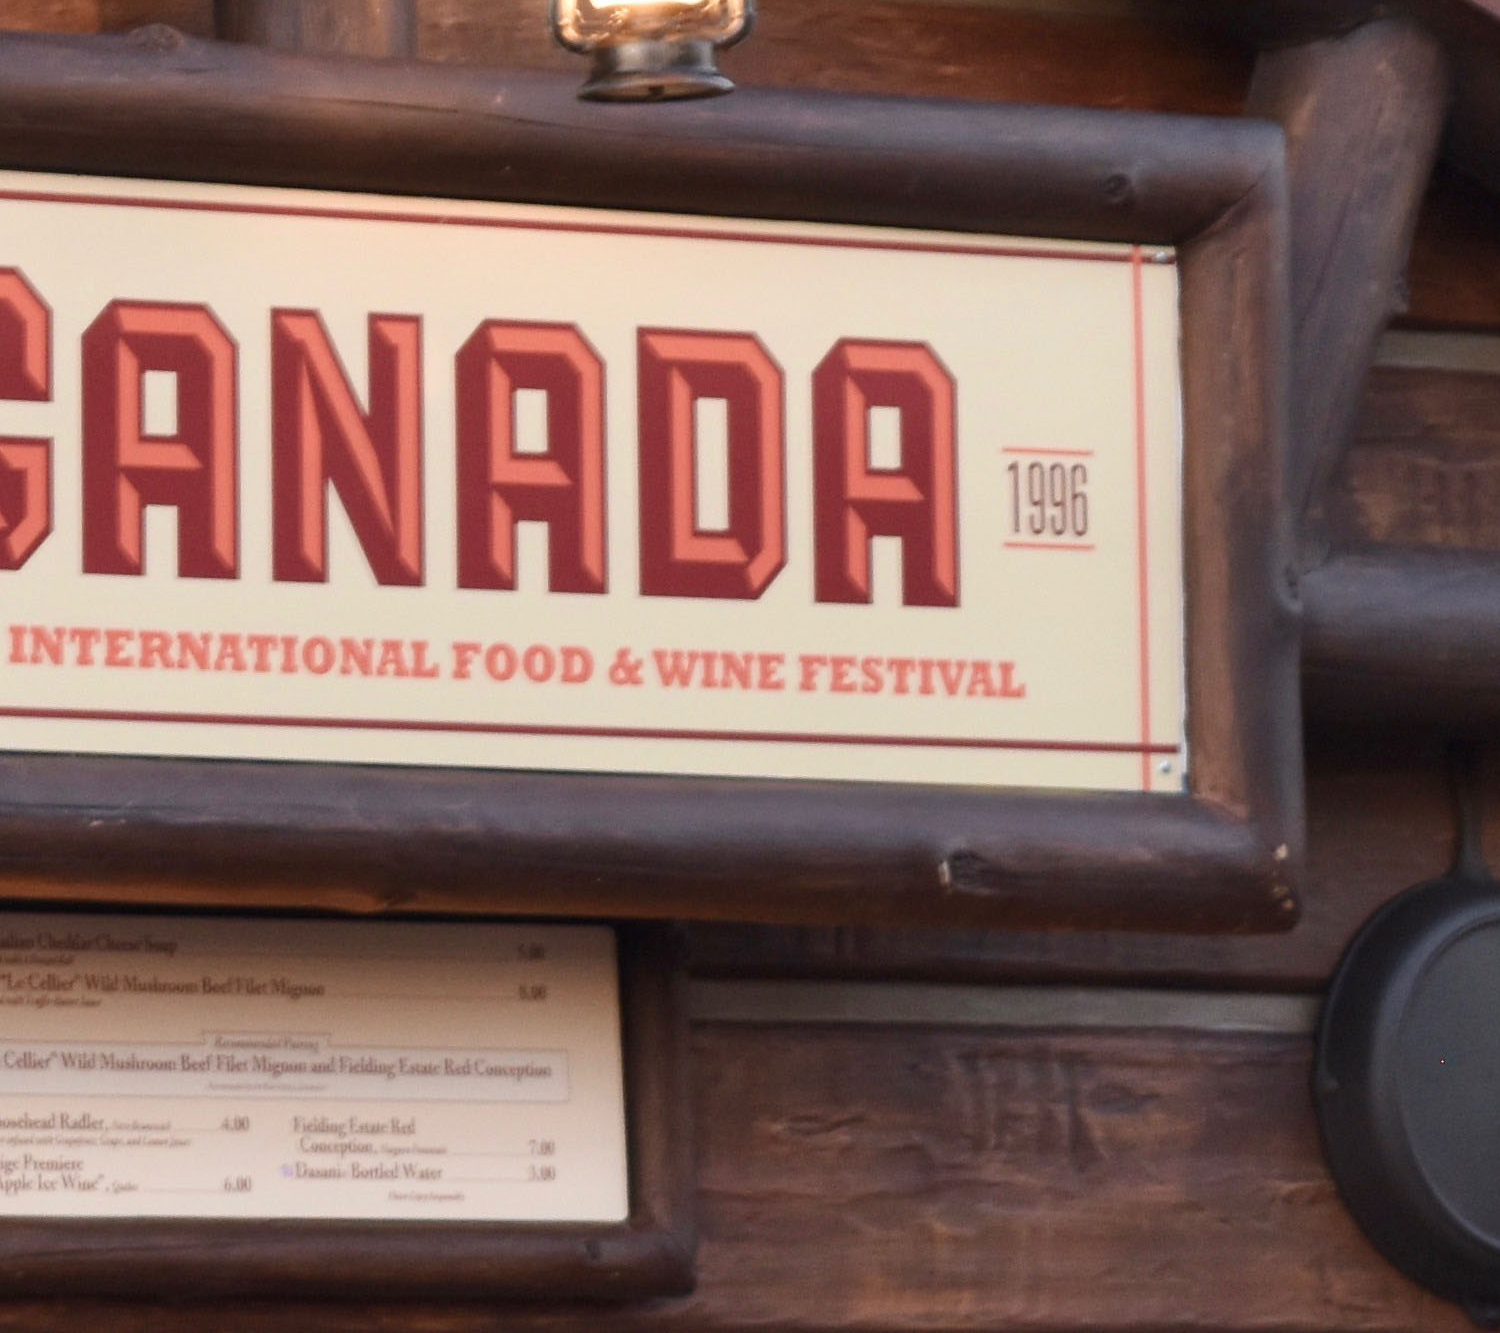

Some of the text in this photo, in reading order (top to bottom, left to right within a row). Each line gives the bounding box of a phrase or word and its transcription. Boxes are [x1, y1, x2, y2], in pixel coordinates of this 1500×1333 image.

[1005, 458, 1091, 541] 1996
[8, 624, 440, 678] INTERNATIONAL
[452, 641, 595, 685] FOOD
[609, 646, 643, 686] &
[651, 648, 786, 692] WINE
[799, 654, 1027, 699] FESTIVAL
[85, 973, 118, 992] Wild
[122, 974, 199, 994] Mushroom
[61, 1051, 96, 1070] Wild
[100, 1051, 176, 1071] Mushroom
[180, 1053, 214, 1072] Beef
[252, 1054, 307, 1077] Mignon
[311, 1056, 336, 1073] and
[399, 1057, 441, 1075] Estate
[444, 1057, 471, 1076] Red
[475, 1059, 552, 1081] Conception
[391, 1118, 416, 1135] Red
[352, 1162, 398, 1179] Bottled
[403, 1164, 444, 1180] Water
